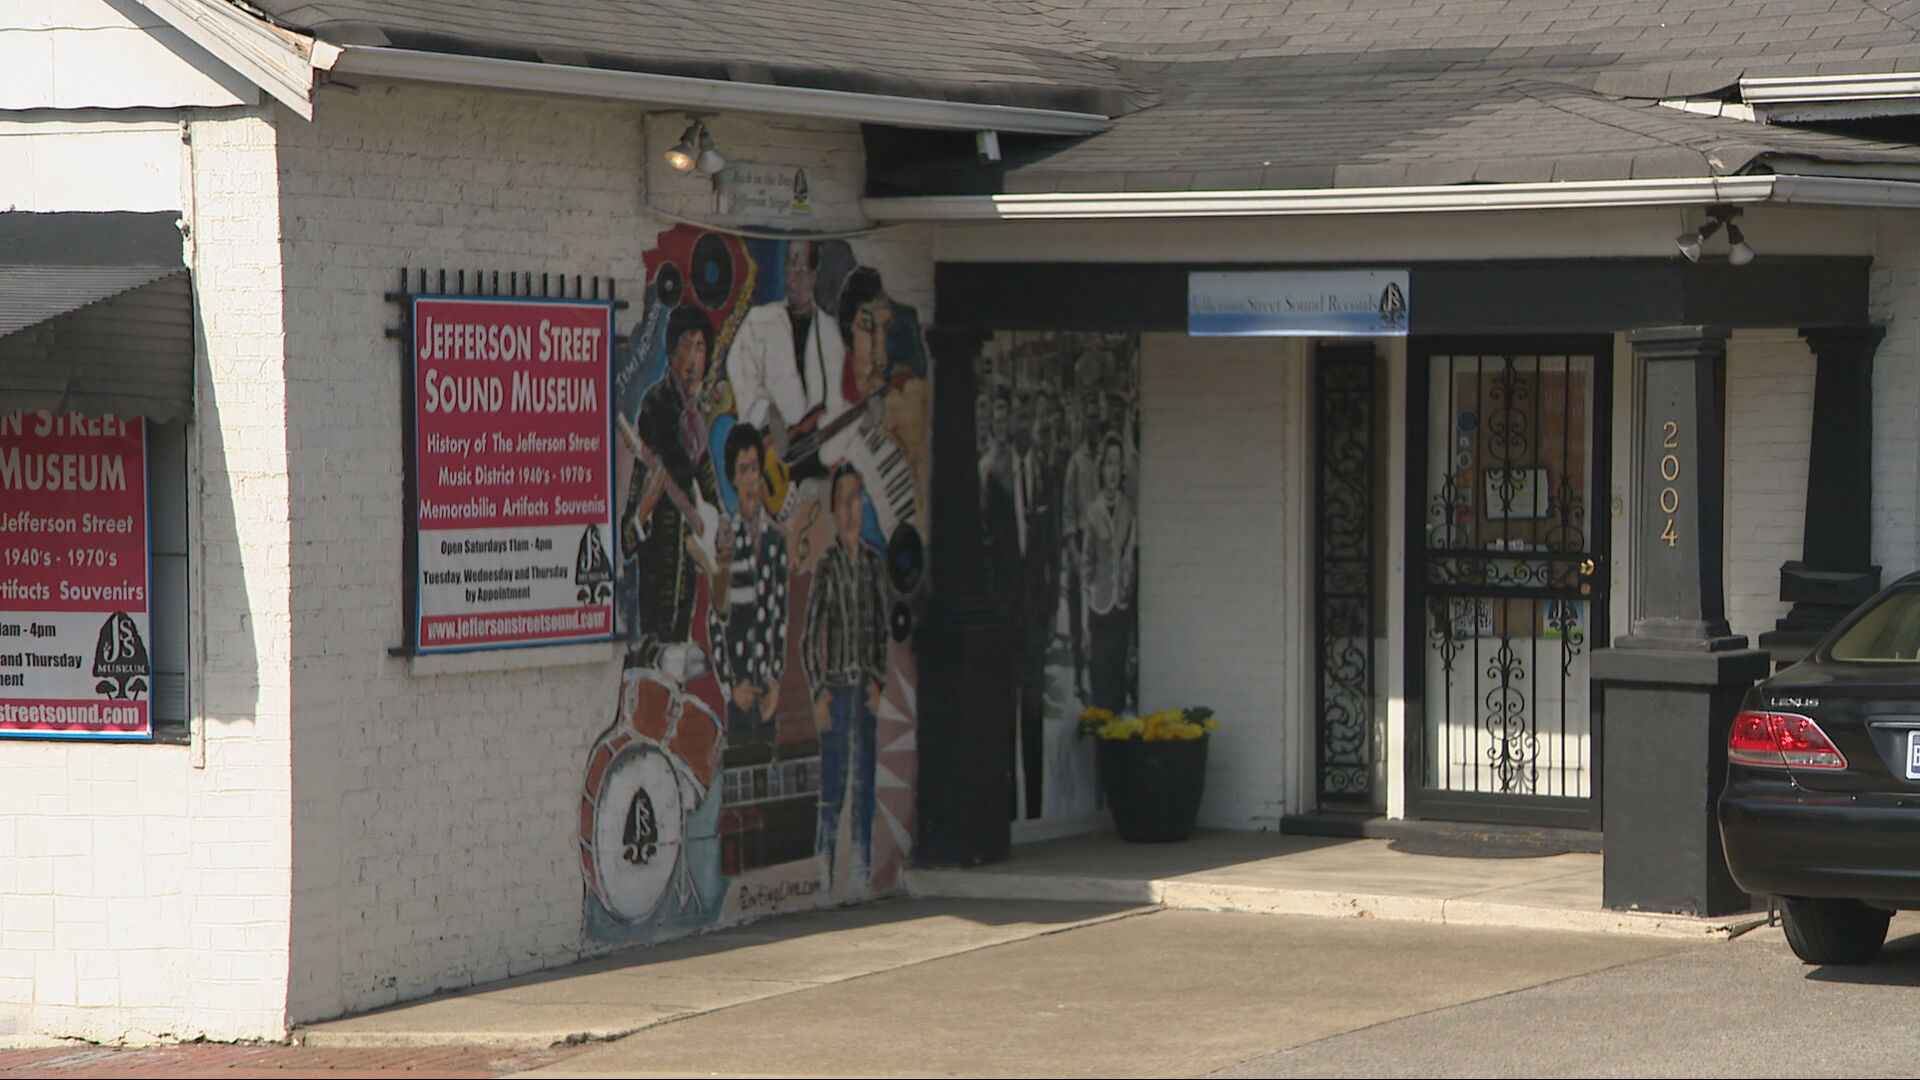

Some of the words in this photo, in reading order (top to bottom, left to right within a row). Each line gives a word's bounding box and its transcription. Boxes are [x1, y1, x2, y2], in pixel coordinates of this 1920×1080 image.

[420, 316, 532, 361] JEFFERSON
[538, 319, 601, 363] STREET
[425, 368, 504, 414] SOUND
[511, 371, 598, 413] MUSEUM
[427, 432, 471, 459] History
[474, 432, 487, 452] of
[492, 432, 513, 452] The
[516, 432, 566, 453] Jefferson
[568, 432, 600, 452] Street
[439, 465, 472, 487] Music
[475, 464, 515, 485] District
[518, 466, 550, 485] 1940's
[560, 466, 593, 484] 1970's
[1660, 421, 1680, 547] 2004
[419, 497, 497, 520] Memorabilia
[502, 496, 549, 517] Artifacts
[0, 511, 77, 533] Jefferson
[82, 512, 134, 534] Street
[4, 548, 51, 567] 1940's
[68, 549, 118, 567] 1970's
[440, 540, 463, 556] Open
[464, 538, 507, 554] Saturdays
[509, 538, 529, 552] 11am
[535, 536, 553, 552] 4pm
[464, 567, 514, 583] Wednesday
[515, 566, 530, 580] and
[531, 565, 568, 580] Thursday
[0, 579, 51, 600] tifacts
[59, 580, 144, 601] Souvenirs
[465, 588, 477, 603] by
[478, 586, 531, 601] Appointment
[29, 622, 56, 639] 4pm
[427, 610, 606, 641] www.jeffersonstreetsound.com
[0, 653, 23, 668] and
[25, 652, 82, 669] Thursday
